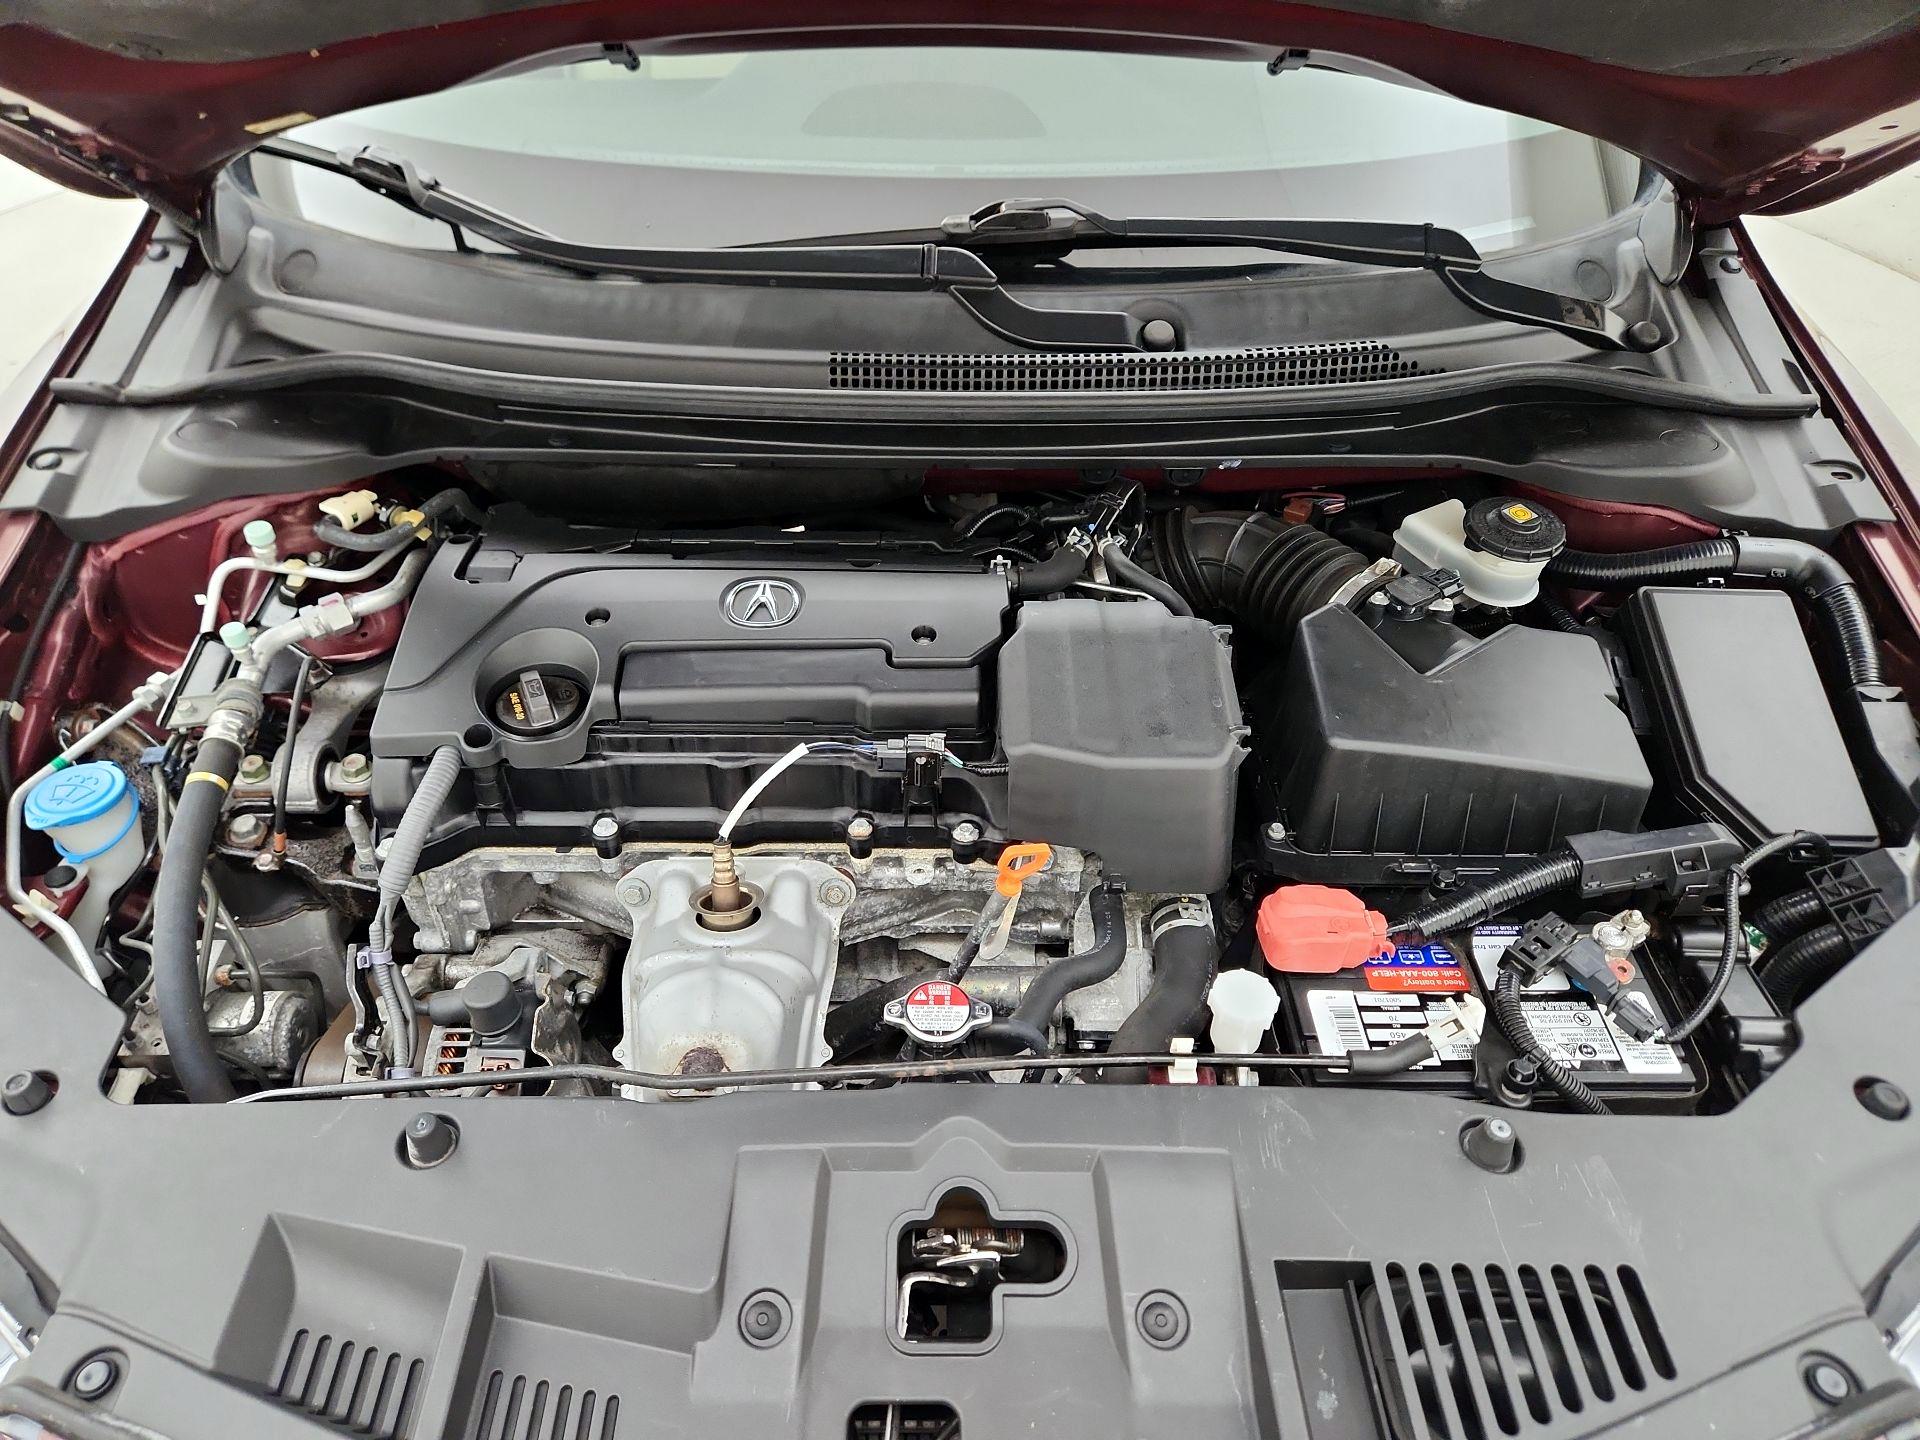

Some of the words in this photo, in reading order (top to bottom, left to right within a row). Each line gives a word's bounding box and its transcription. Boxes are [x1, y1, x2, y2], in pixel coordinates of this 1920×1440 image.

[509, 692, 520, 704] SAE
[1371, 969, 1439, 977] 800-AAA-HELP
[1403, 978, 1436, 987] battery?
[1389, 1031, 1407, 1039] 450
